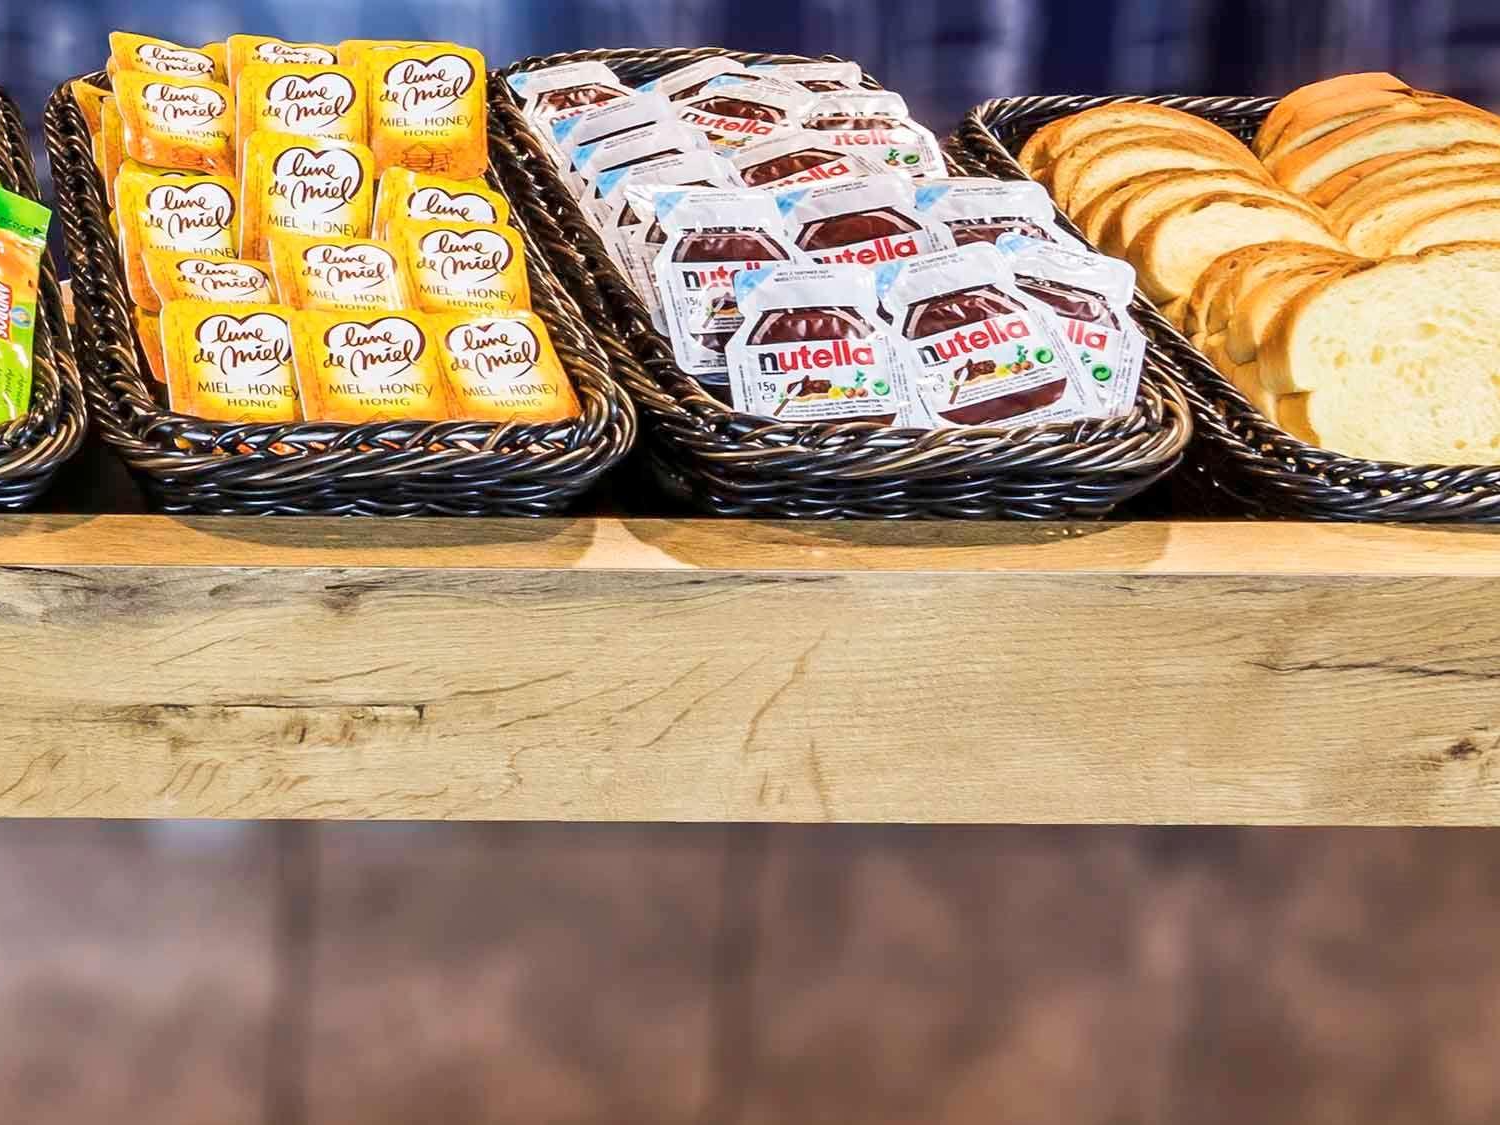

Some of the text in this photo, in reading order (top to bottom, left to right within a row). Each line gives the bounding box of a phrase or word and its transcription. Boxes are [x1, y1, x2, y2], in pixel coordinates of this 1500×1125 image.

[379, 114, 474, 128] MIEL HONEY
[682, 112, 773, 137] nutella
[402, 128, 450, 138] HONIG
[419, 283, 517, 305] MIEL HONEY
[917, 318, 1031, 365] nutella
[759, 339, 876, 374] nutella
[197, 381, 299, 398] MIEL HONEY
[328, 383, 433, 399] MIEL HONEY
[462, 384, 560, 399] MIEL HONEY
[226, 397, 278, 409] HONIG
[358, 397, 412, 408] HONIG
[492, 397, 543, 408] HONIG
